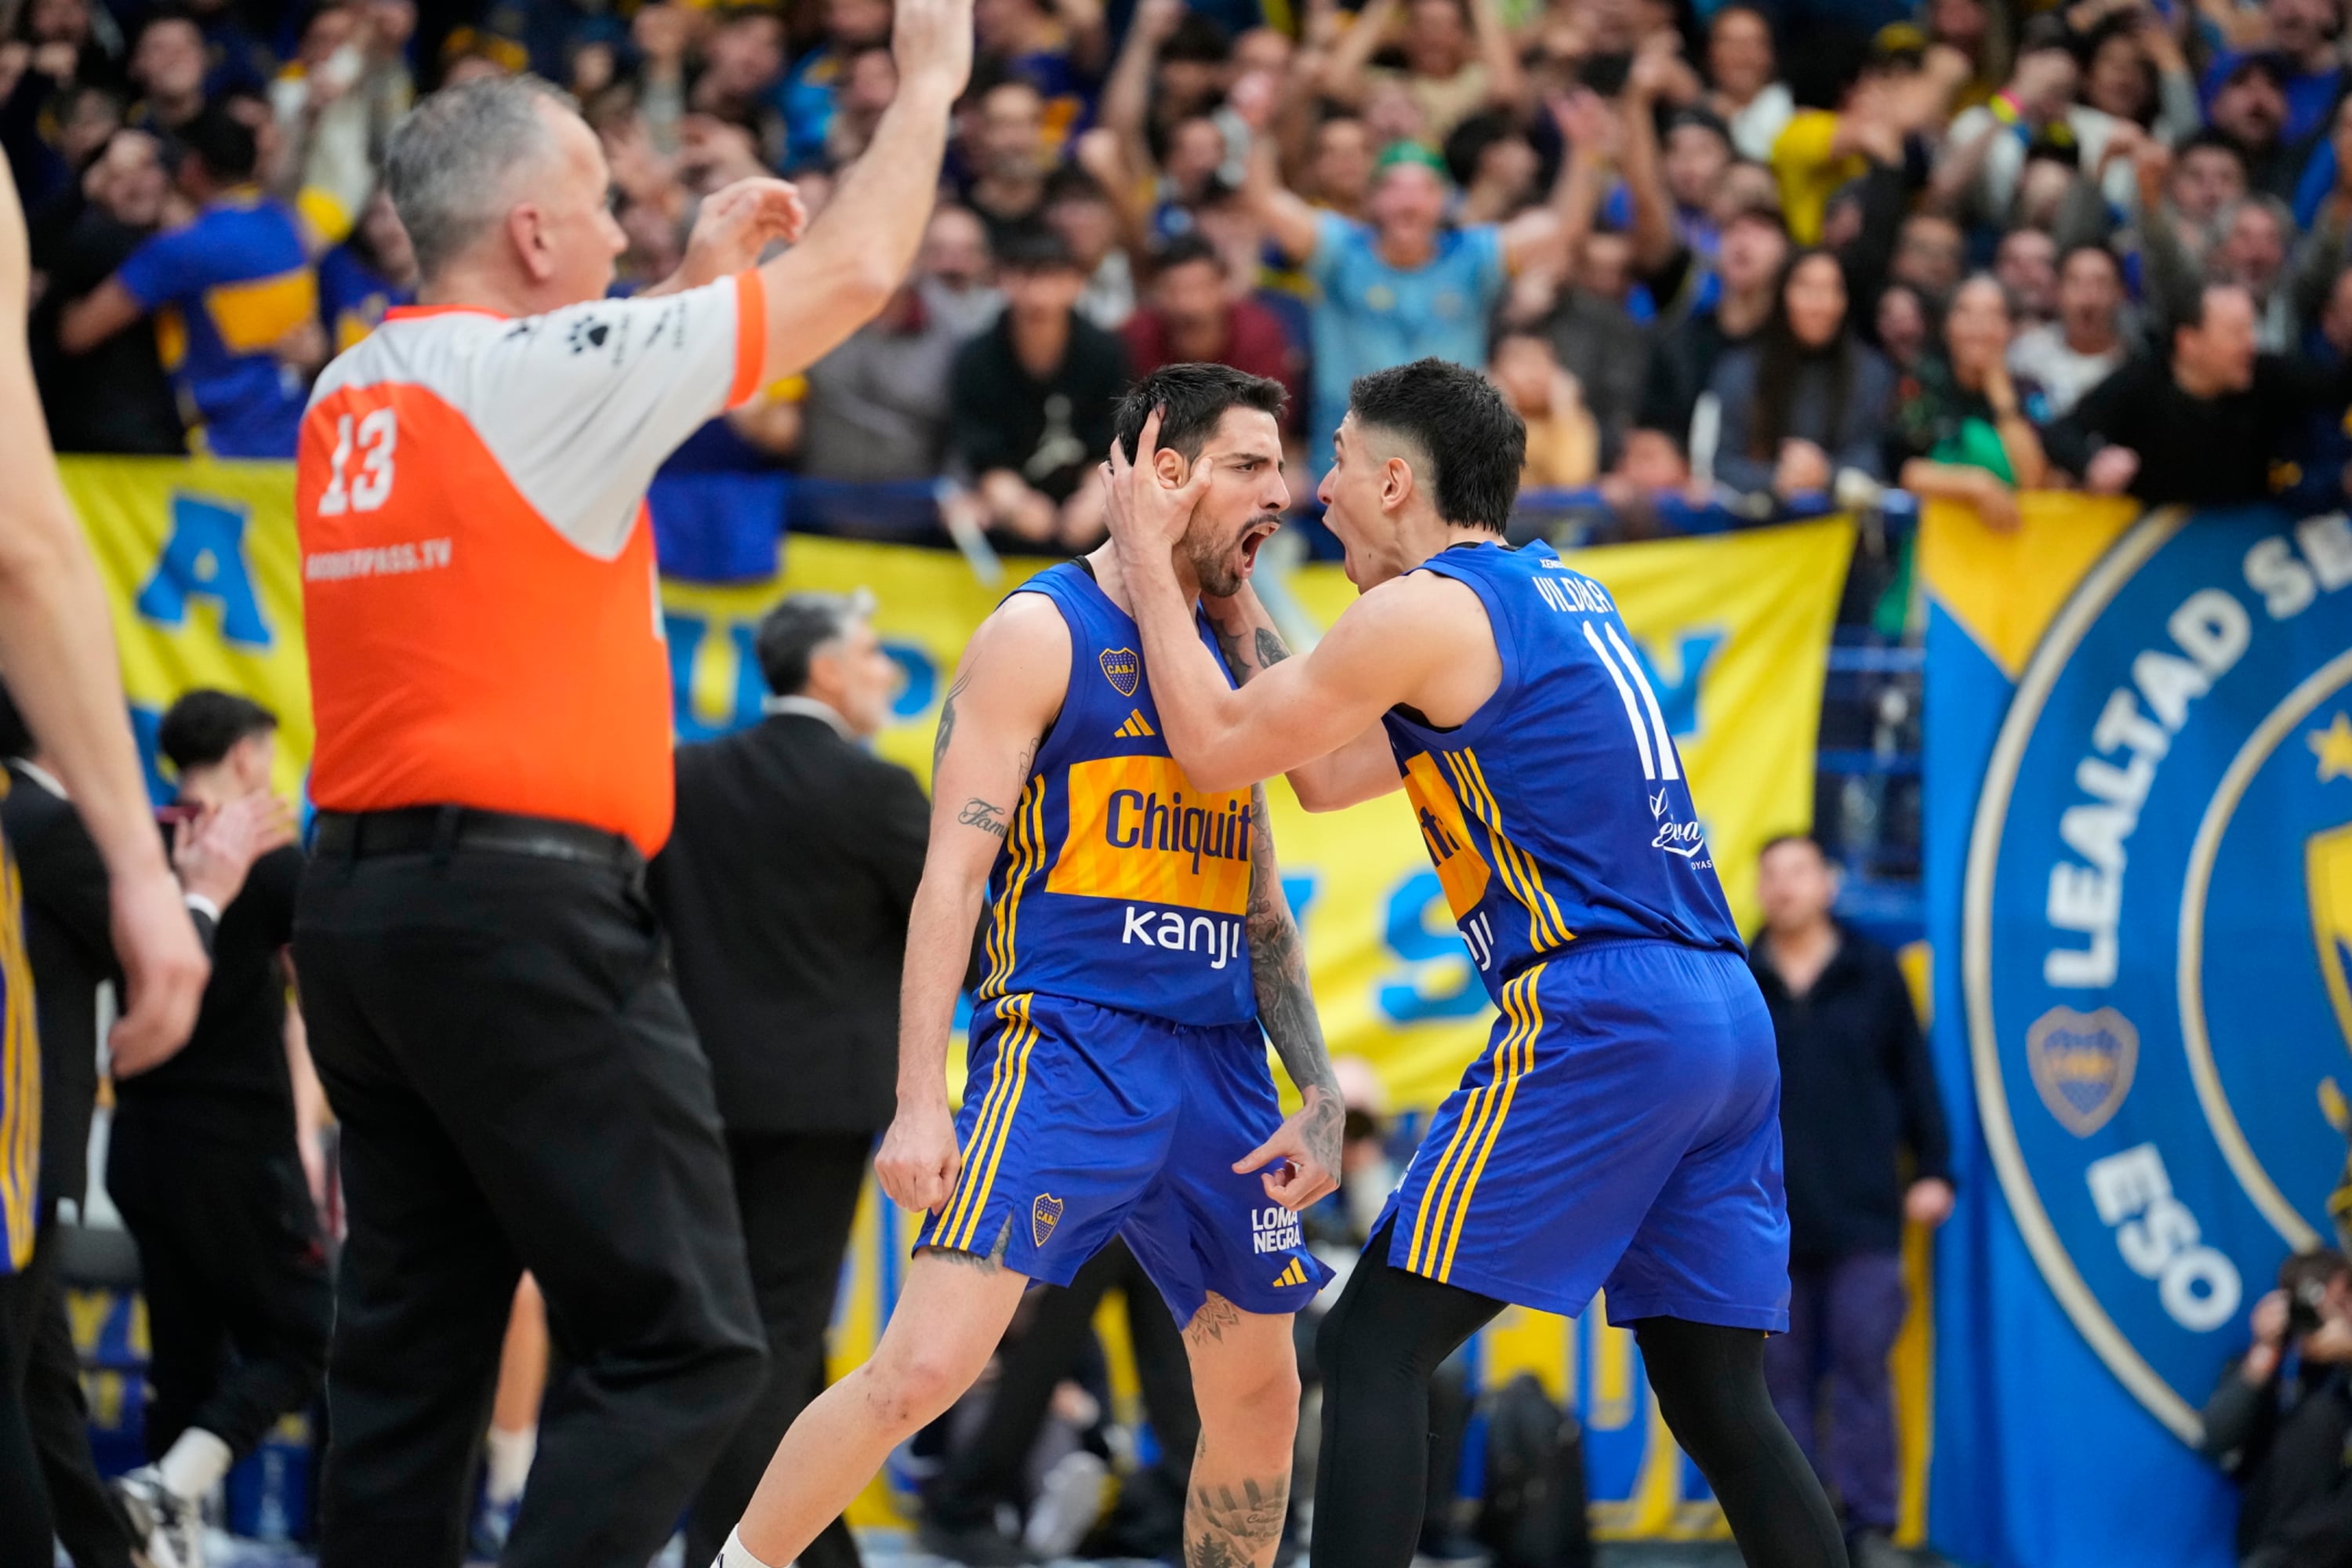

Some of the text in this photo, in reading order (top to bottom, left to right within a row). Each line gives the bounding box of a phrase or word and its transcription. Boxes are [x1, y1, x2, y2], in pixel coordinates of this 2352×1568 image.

[317, 405, 397, 517] 13
[1106, 663, 1135, 674] CABJ
[1582, 619, 1680, 781] 11
[1105, 788, 1252, 876] Chiquit
[2042, 587, 2252, 989] LEALTAD
[1251, 1207, 1298, 1232] LOMA
[1253, 1224, 1301, 1254] NEGRA
[2084, 1141, 2243, 1334] ESO
